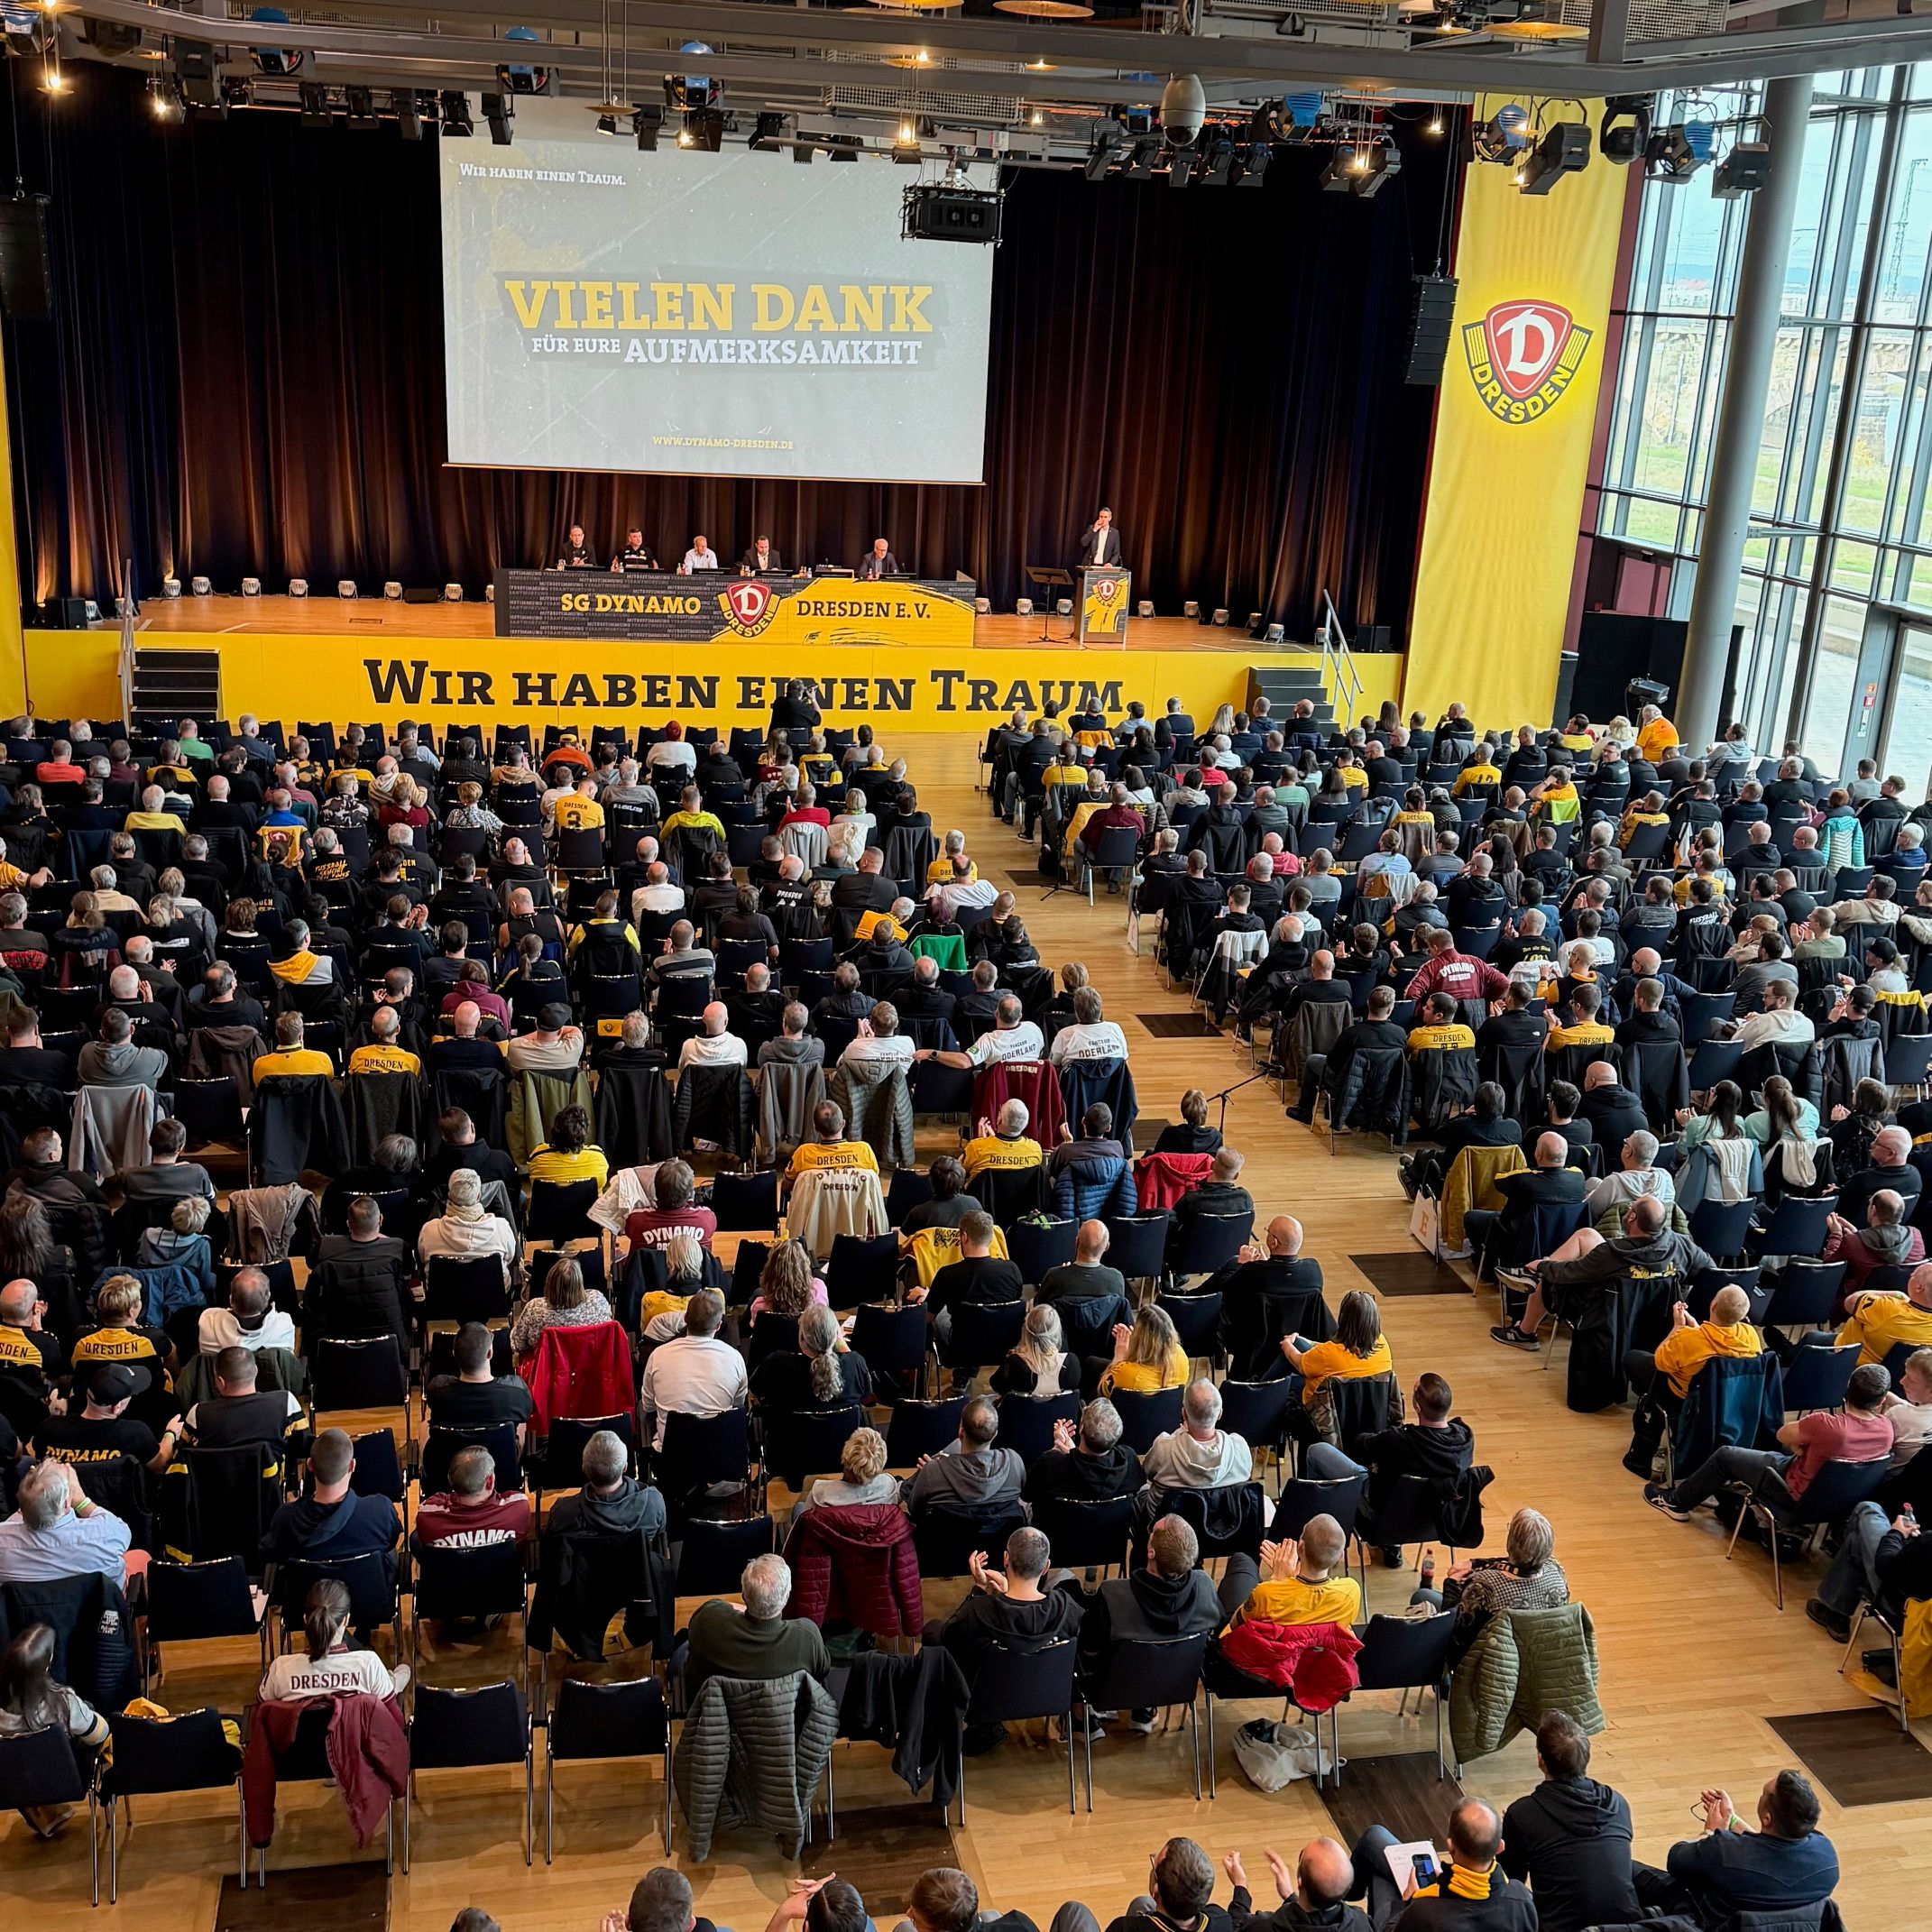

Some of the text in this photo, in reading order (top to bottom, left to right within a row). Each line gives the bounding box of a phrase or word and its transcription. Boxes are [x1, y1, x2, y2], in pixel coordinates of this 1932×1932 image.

[489, 167, 533, 180] HABEN
[536, 170, 575, 182] EINEN
[504, 281, 934, 332] VIELEN DANK
[531, 334, 923, 364] FÜR EURE AUFMERKSAMKEIT
[1472, 364, 1573, 423] DRESDEN
[652, 436, 794, 449] WWW.DYNAMO-DRESDEN.DE
[560, 593, 702, 615] SG DYNAMO
[796, 600, 931, 619] DRESDEN E. V.
[722, 610, 774, 637] DRESDEN
[363, 658, 495, 705] WIR
[511, 672, 720, 709] HABEN
[930, 669, 1124, 713] TRAUM
[1433, 1034, 1467, 1043] DRESDEN
[364, 1058, 404, 1070] DRESDEN
[816, 1154, 859, 1166] DRESDEN
[989, 1155, 1030, 1165] DRESDEN
[816, 1167, 868, 1182] DYNAMO
[823, 1182, 859, 1192] DRESDN
[642, 1225, 705, 1245] DYNAMO
[85, 1341, 139, 1356] DRESDEN
[290, 1671, 360, 1690] DRESDEN
